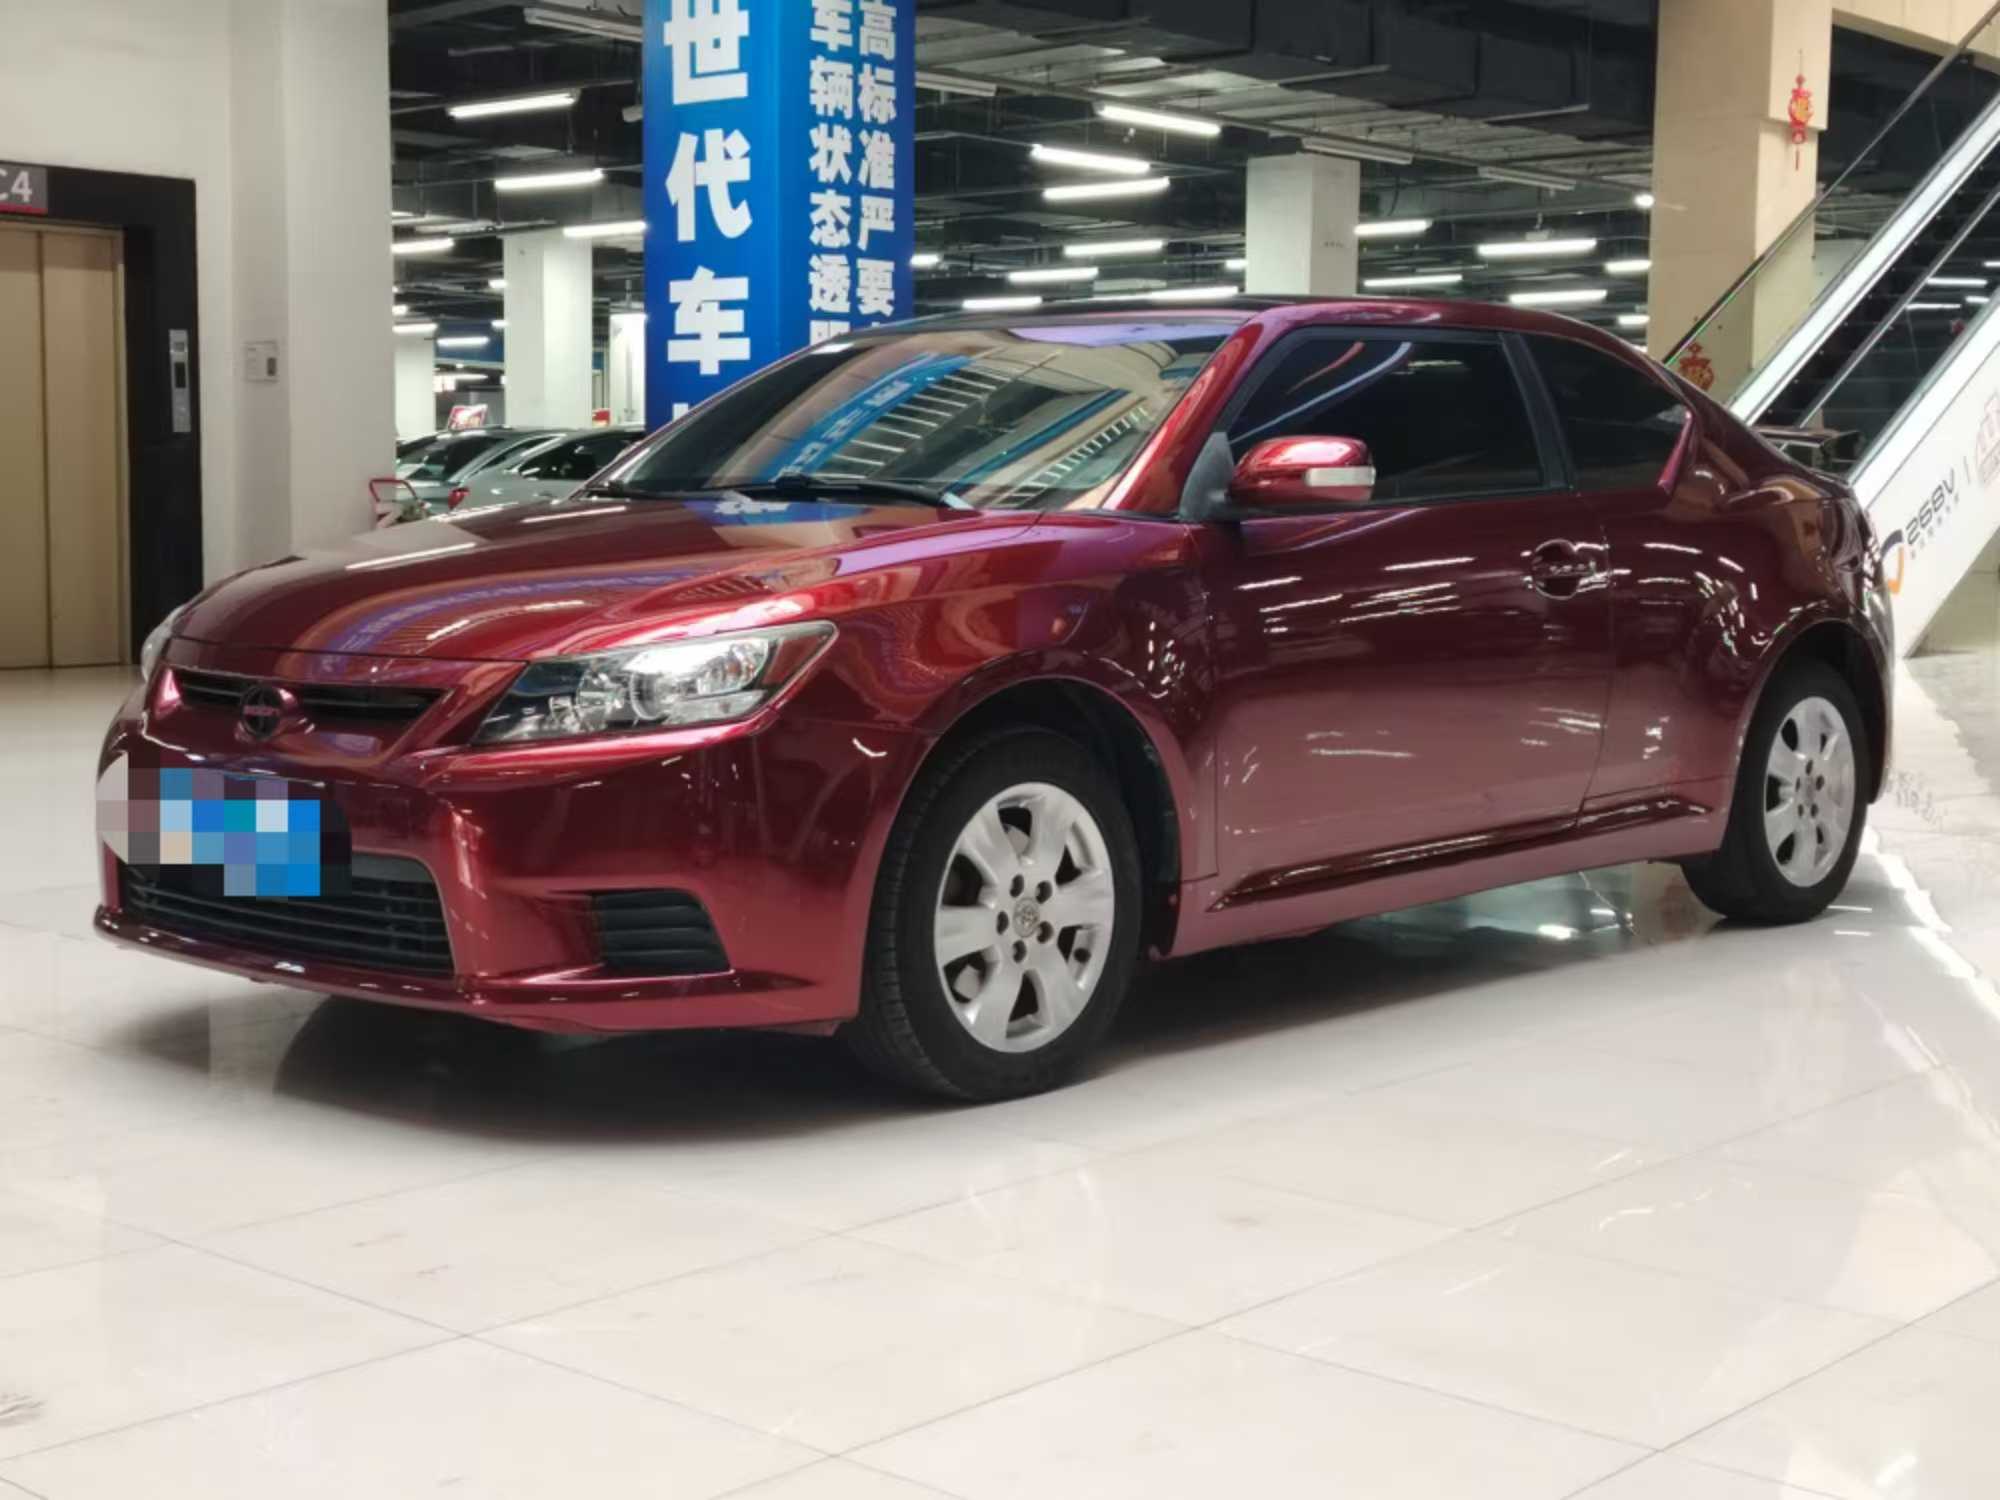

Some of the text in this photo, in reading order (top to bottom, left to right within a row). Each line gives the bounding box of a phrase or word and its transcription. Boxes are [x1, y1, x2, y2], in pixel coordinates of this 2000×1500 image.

[664, 0, 752, 421] 世代车
[857, 0, 897, 328] 高标准严要
